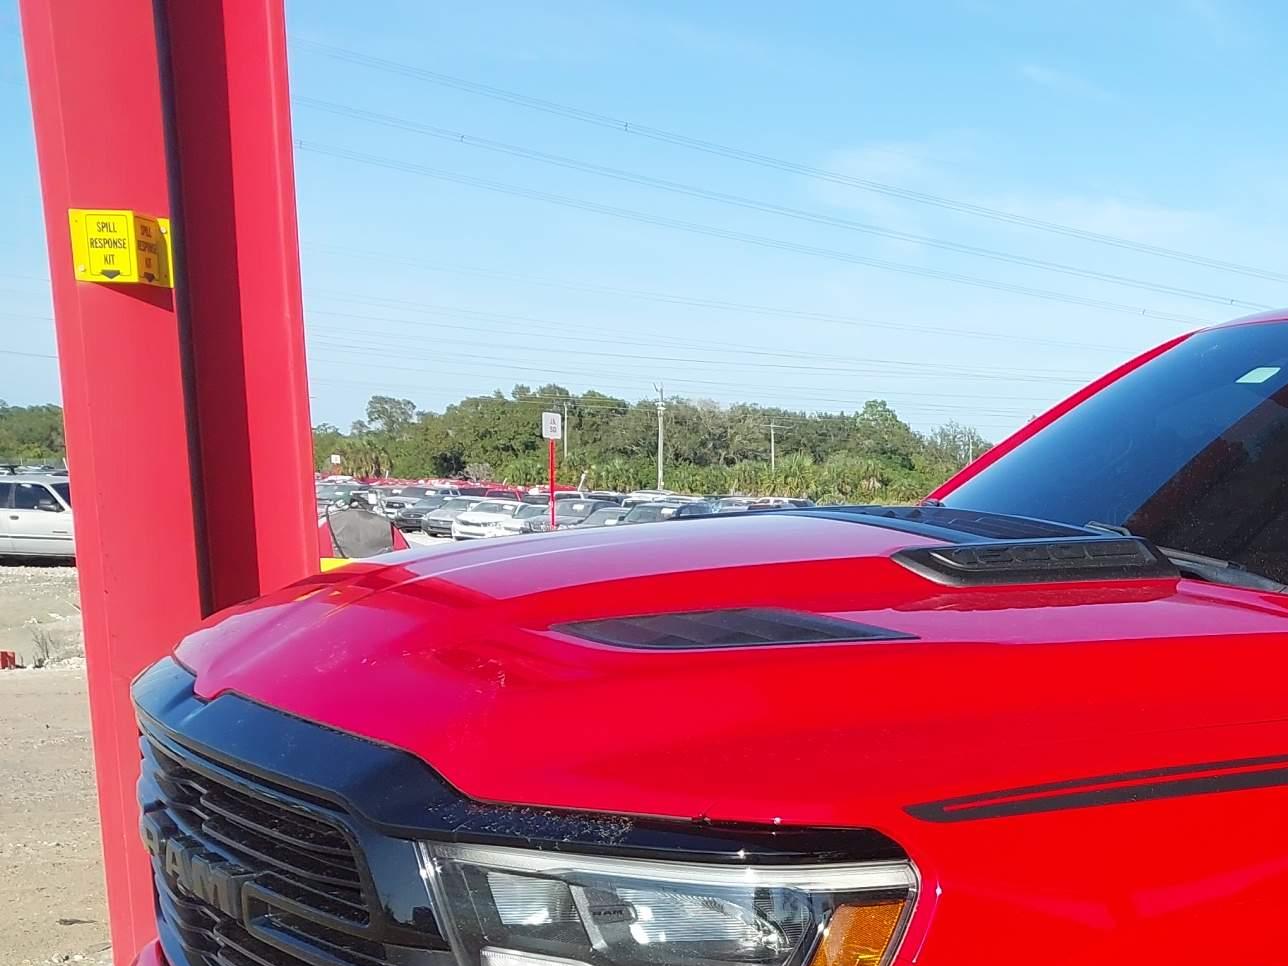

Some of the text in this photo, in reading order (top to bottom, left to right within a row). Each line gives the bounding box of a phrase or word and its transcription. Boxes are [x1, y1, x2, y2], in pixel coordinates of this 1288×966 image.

[96, 222, 118, 233] SPILL
[89, 238, 127, 249] RESPONSE
[104, 254, 115, 265] KIT
